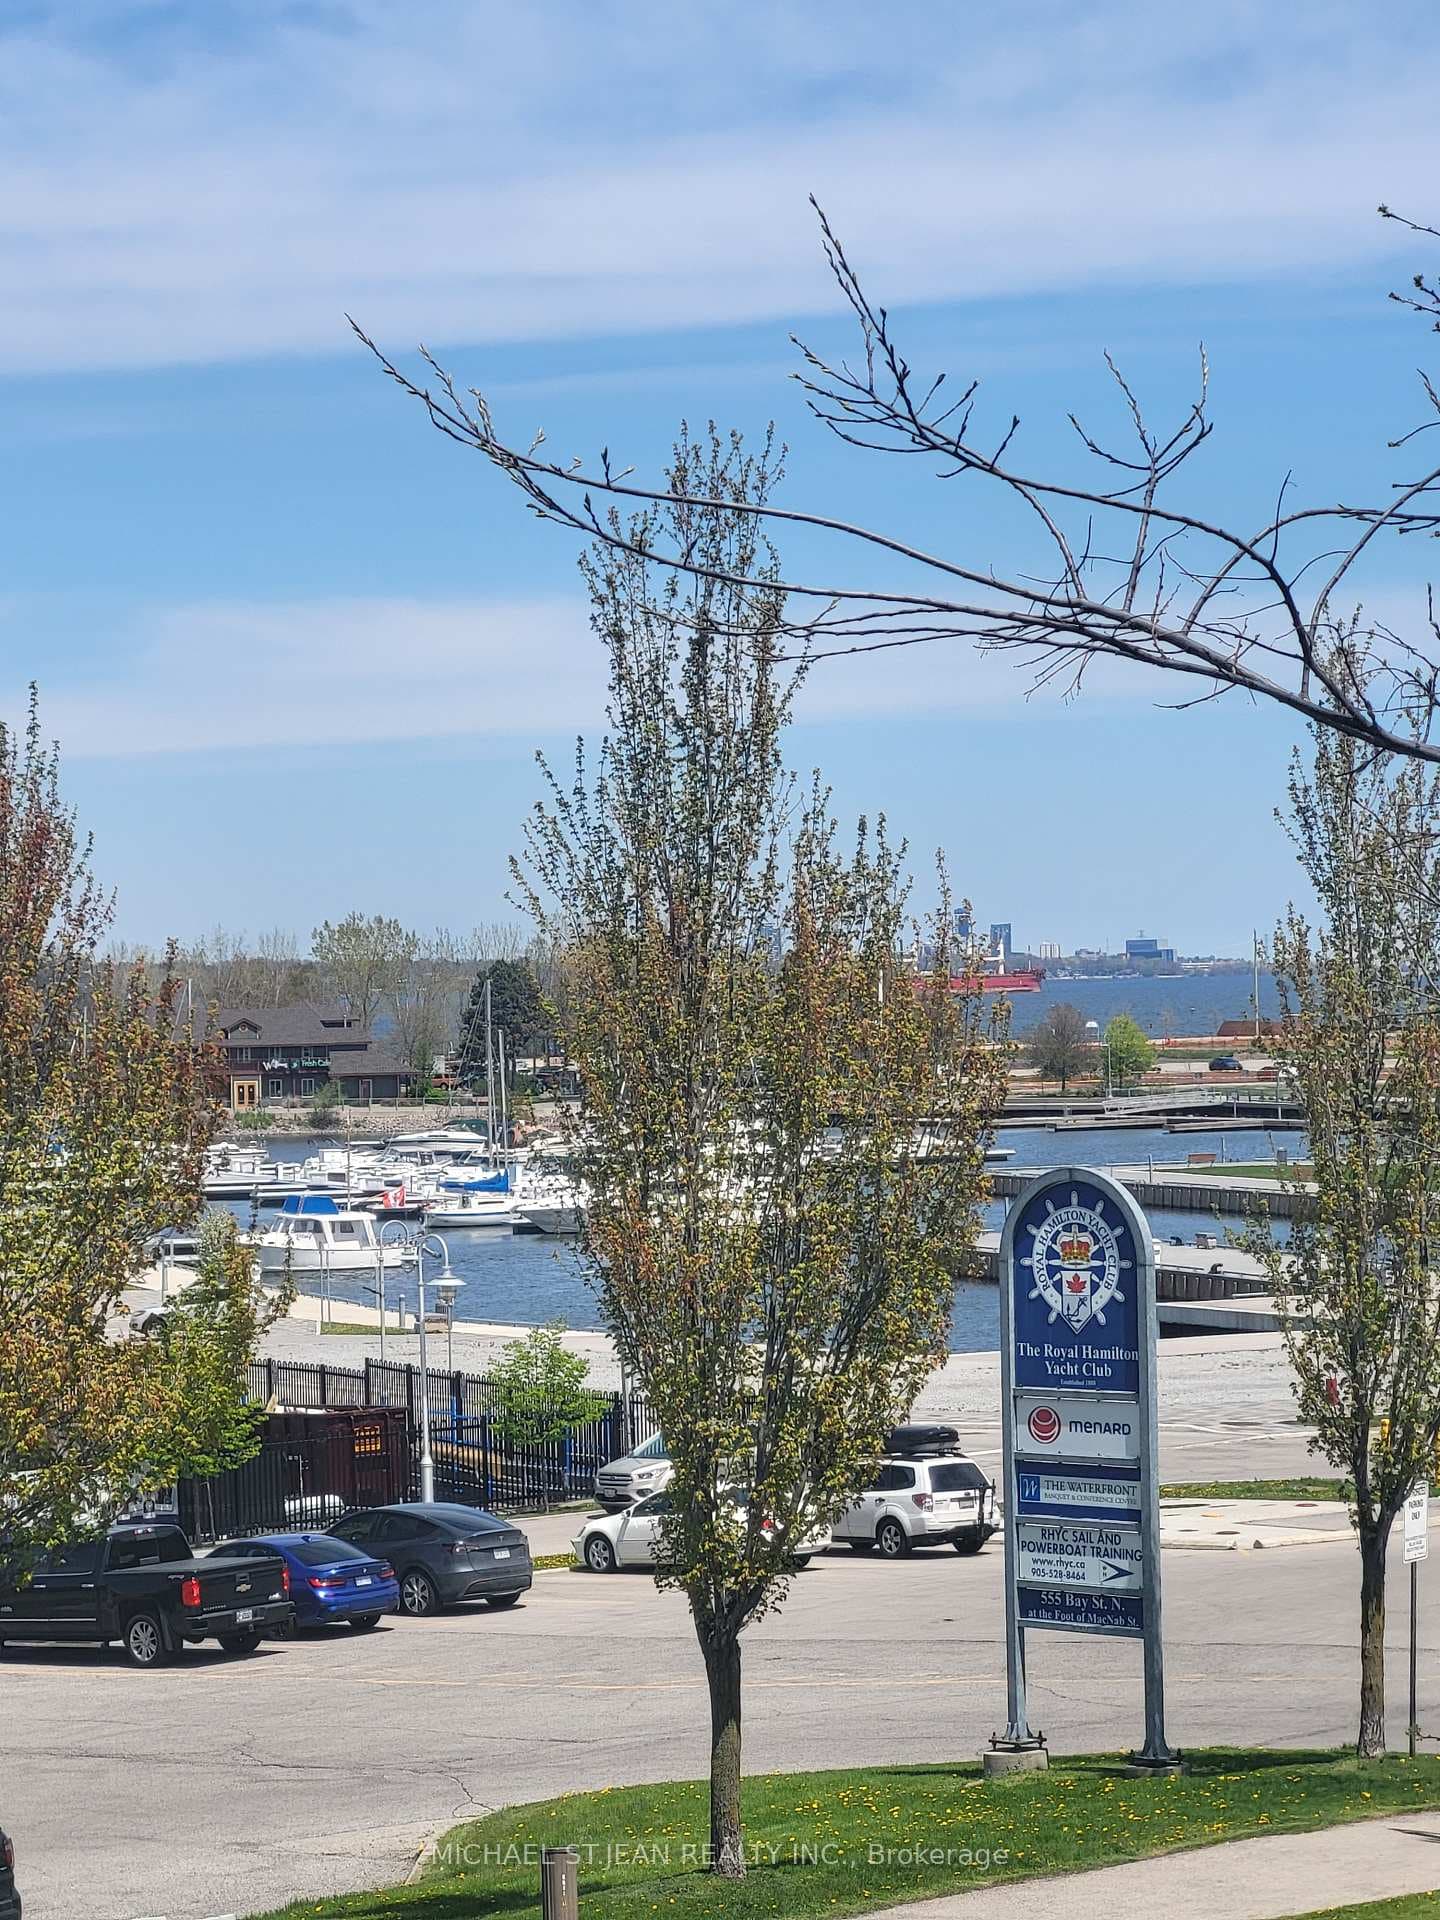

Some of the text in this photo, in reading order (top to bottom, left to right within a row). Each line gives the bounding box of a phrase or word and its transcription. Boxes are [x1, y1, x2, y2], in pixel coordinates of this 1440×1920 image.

[1036, 1210, 1117, 1291] ROYAL HAMILTON YACHT CLUB
[1017, 1342, 1139, 1361] The Royal Hamilton
[1045, 1361, 1112, 1377] Yacht Club
[1044, 1479, 1137, 1497] THE WATERFRONT
[1041, 1528, 1122, 1546] RHYC SAIL AND
[1021, 1540, 1144, 1562] POWERBOAT TRAINING
[1031, 1557, 1086, 1571] www.rhyc.ca
[1031, 1567, 1086, 1581] 905-528-8464
[1040, 1591, 1125, 1611] 555 Bay St. N.
[1028, 1608, 1140, 1627] at the Foot of MacNab St.
